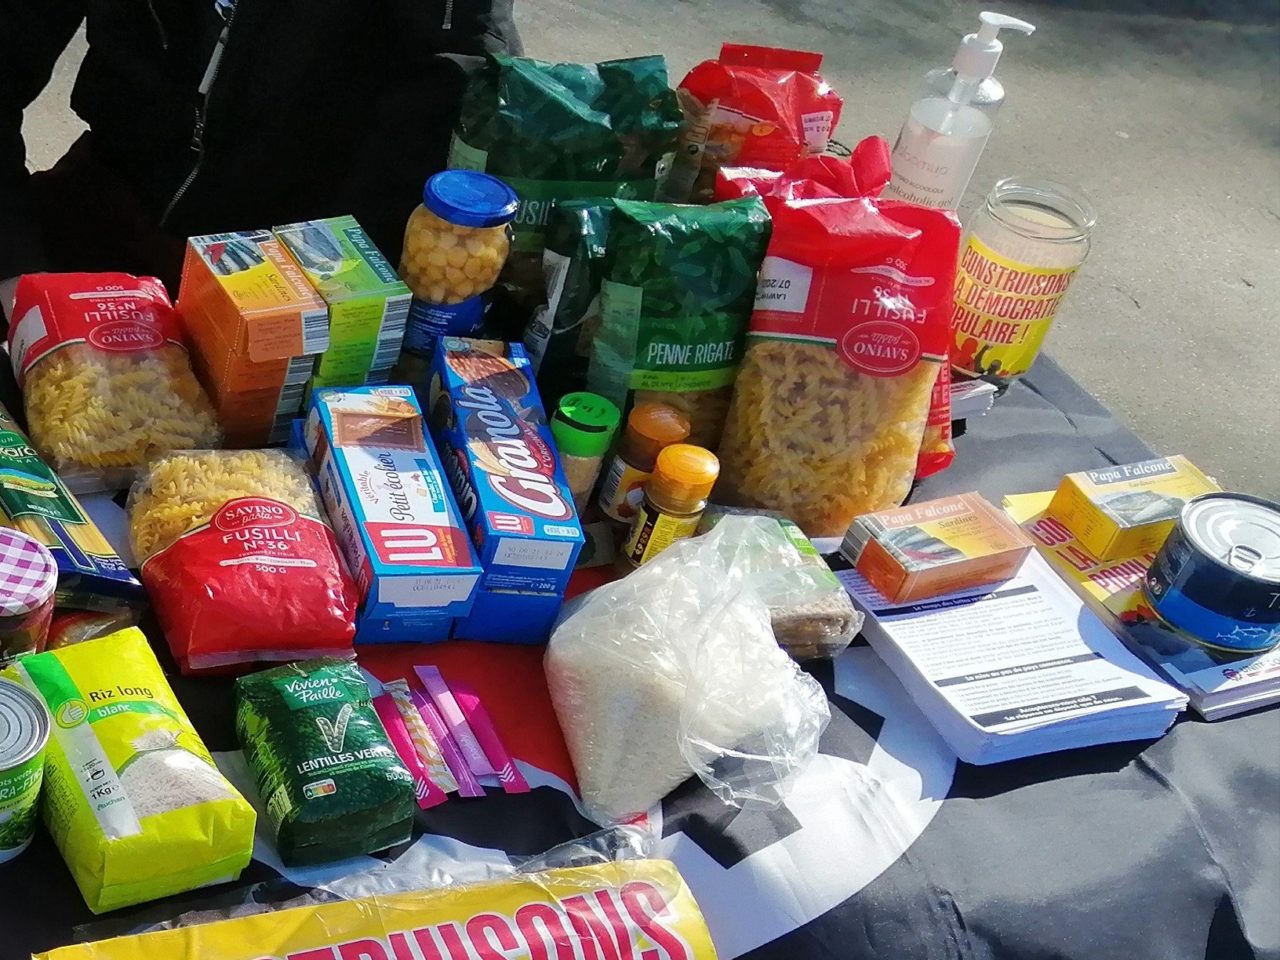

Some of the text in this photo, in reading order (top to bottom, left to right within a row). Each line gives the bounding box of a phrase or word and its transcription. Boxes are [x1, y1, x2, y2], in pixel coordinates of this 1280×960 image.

[514, 200, 550, 226] USIL
[349, 227, 396, 283] Papa Falcone
[265, 243, 313, 298] Papa Falcone
[960, 245, 1075, 297] CONSTRUISONS
[84, 312, 155, 323] FUSILLI
[851, 298, 927, 325] FUSILLI
[101, 334, 155, 344] SAVINO
[871, 332, 902, 343] pasta
[647, 342, 693, 365] PENNE
[853, 342, 910, 361] SAVINO
[459, 385, 569, 518] Granola
[1090, 460, 1173, 484] Papa Falcone
[384, 451, 415, 523] Petit écolier
[225, 505, 284, 521] SAVINO
[242, 511, 273, 526] pasta
[880, 501, 966, 527] Papa Falcone
[936, 514, 979, 529] Sardines
[495, 514, 522, 531] LU
[222, 528, 301, 545] FUSILLI
[243, 540, 289, 551] N°36
[380, 528, 444, 562] LU
[1055, 545, 1100, 572] LA
[255, 565, 276, 573] 500
[89, 686, 154, 703] Riz long
[285, 678, 332, 693] Vivien
[294, 687, 345, 703] Paille
[97, 701, 131, 719] blanc
[296, 752, 356, 775] LENTILLES
